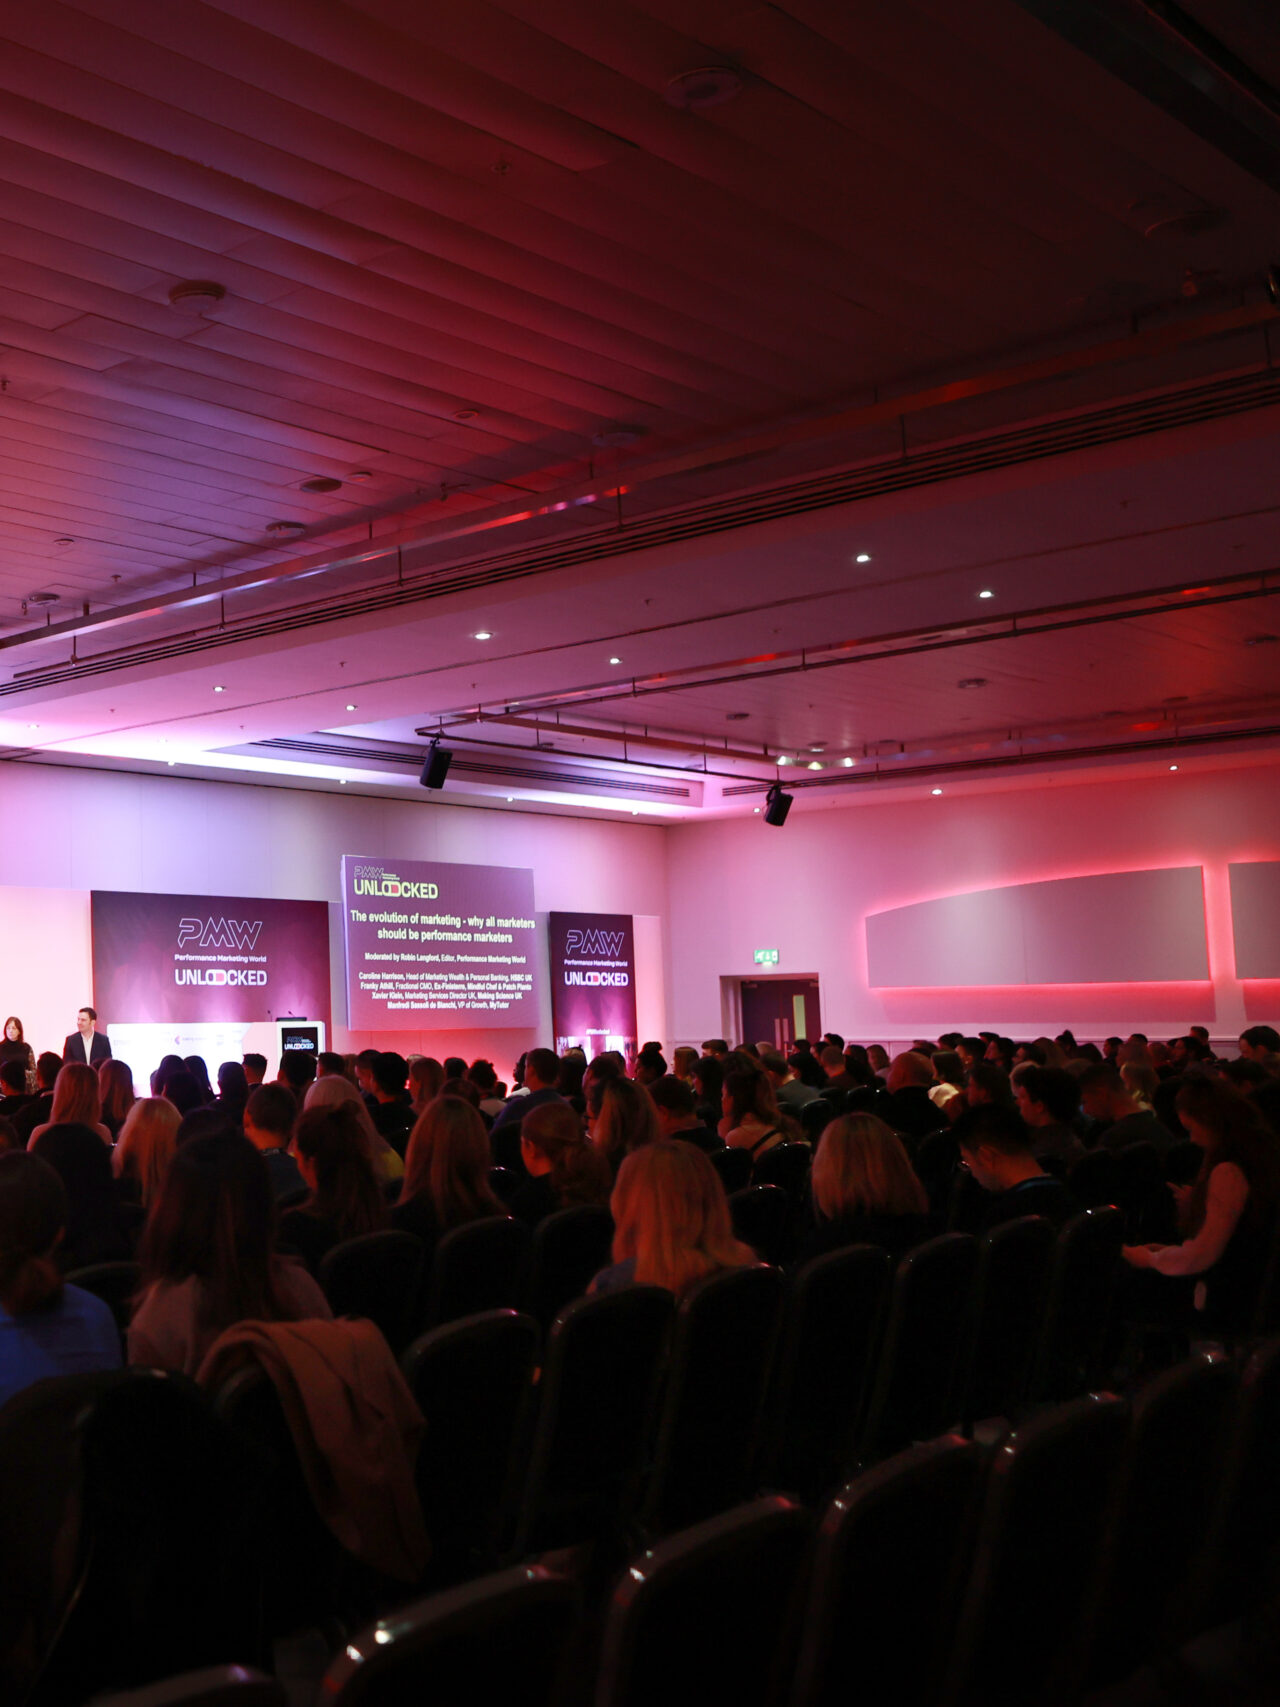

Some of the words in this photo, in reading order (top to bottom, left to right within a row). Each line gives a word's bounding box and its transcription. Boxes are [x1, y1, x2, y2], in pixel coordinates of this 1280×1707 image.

[350, 909, 367, 922] The
[369, 911, 409, 924] evolution
[410, 912, 419, 924] of
[420, 913, 461, 928] marketing
[468, 915, 484, 929] why
[486, 916, 495, 927] all
[497, 917, 536, 929] marketers
[178, 916, 263, 950] PMW
[377, 928, 406, 940] should
[408, 929, 419, 940] be
[421, 929, 472, 943] performance
[473, 931, 513, 943] marketers
[566, 928, 624, 957] PMW
[174, 954, 216, 962] Performance
[217, 954, 248, 963] Marketing
[249, 955, 267, 963] World
